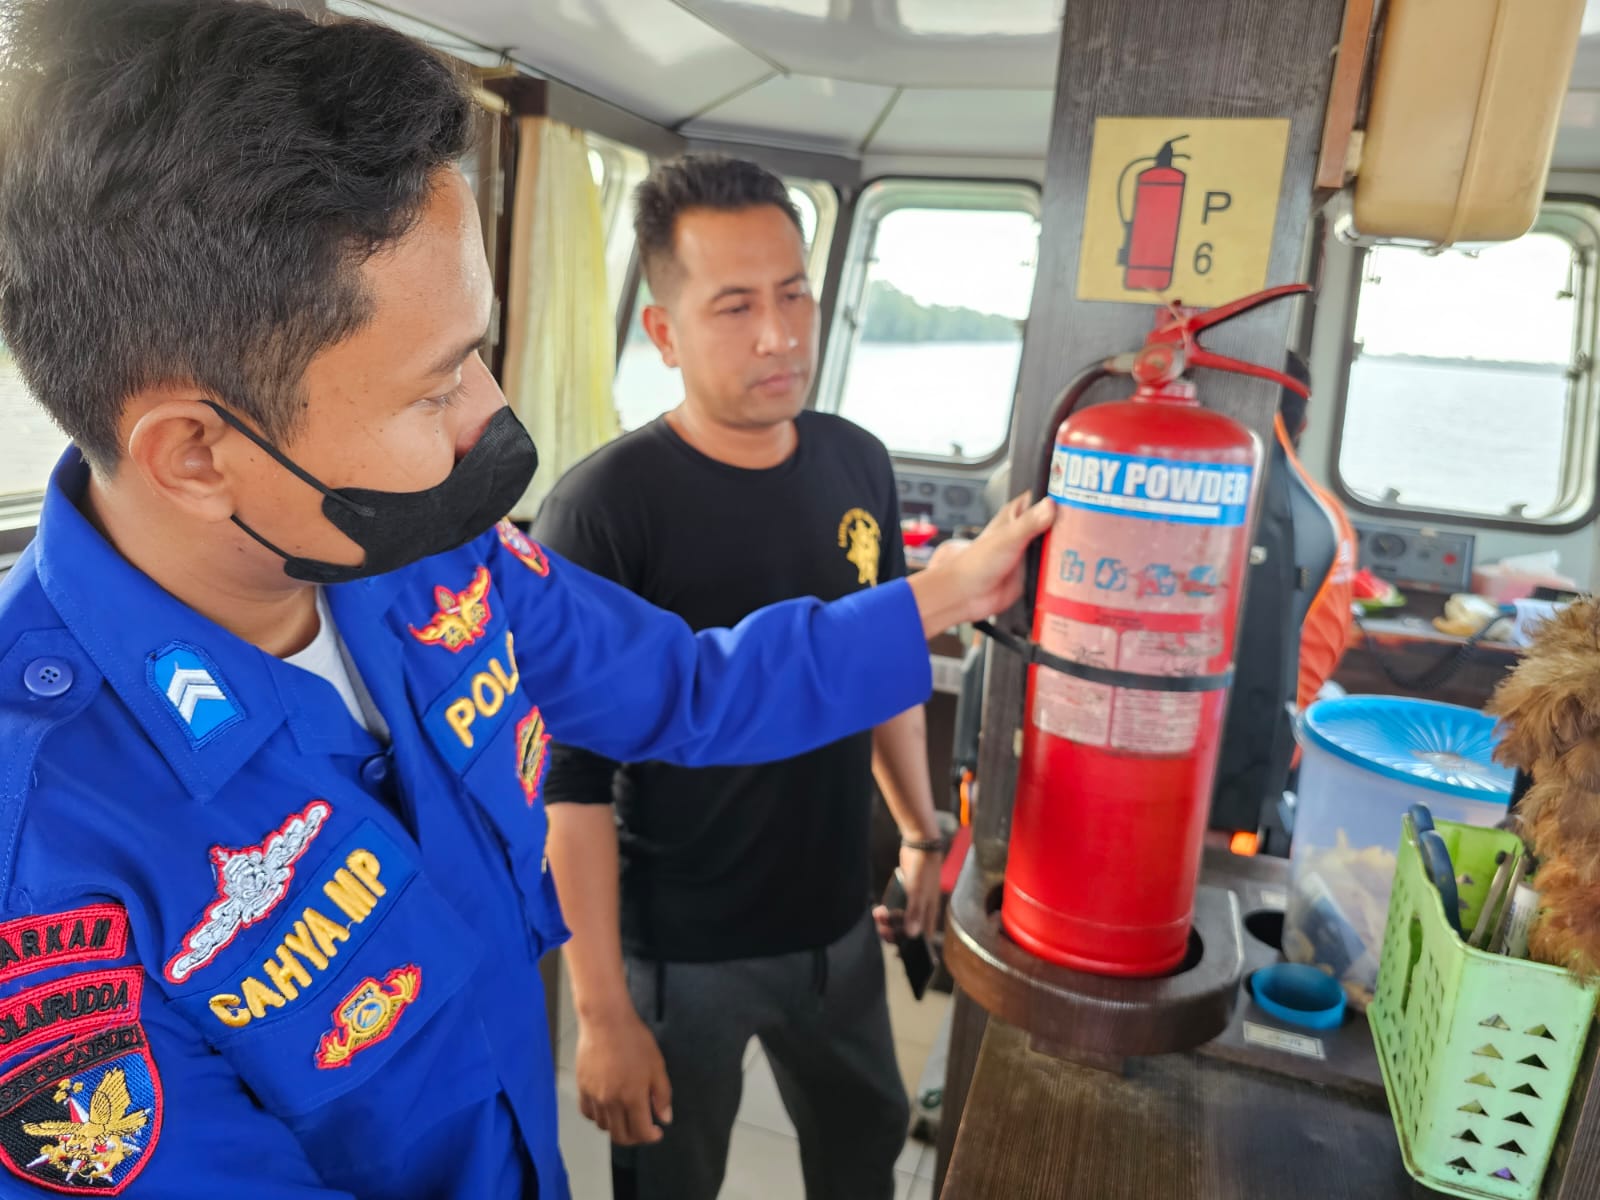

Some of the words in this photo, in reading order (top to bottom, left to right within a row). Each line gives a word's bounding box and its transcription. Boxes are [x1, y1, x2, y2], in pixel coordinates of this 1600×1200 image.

[1201, 190, 1232, 225] P
[1193, 242, 1213, 275] 6
[1066, 454, 1121, 492] DRY
[1122, 461, 1249, 506] POWDER
[208, 906, 350, 1027] CAHYA
[323, 848, 387, 923] MP
